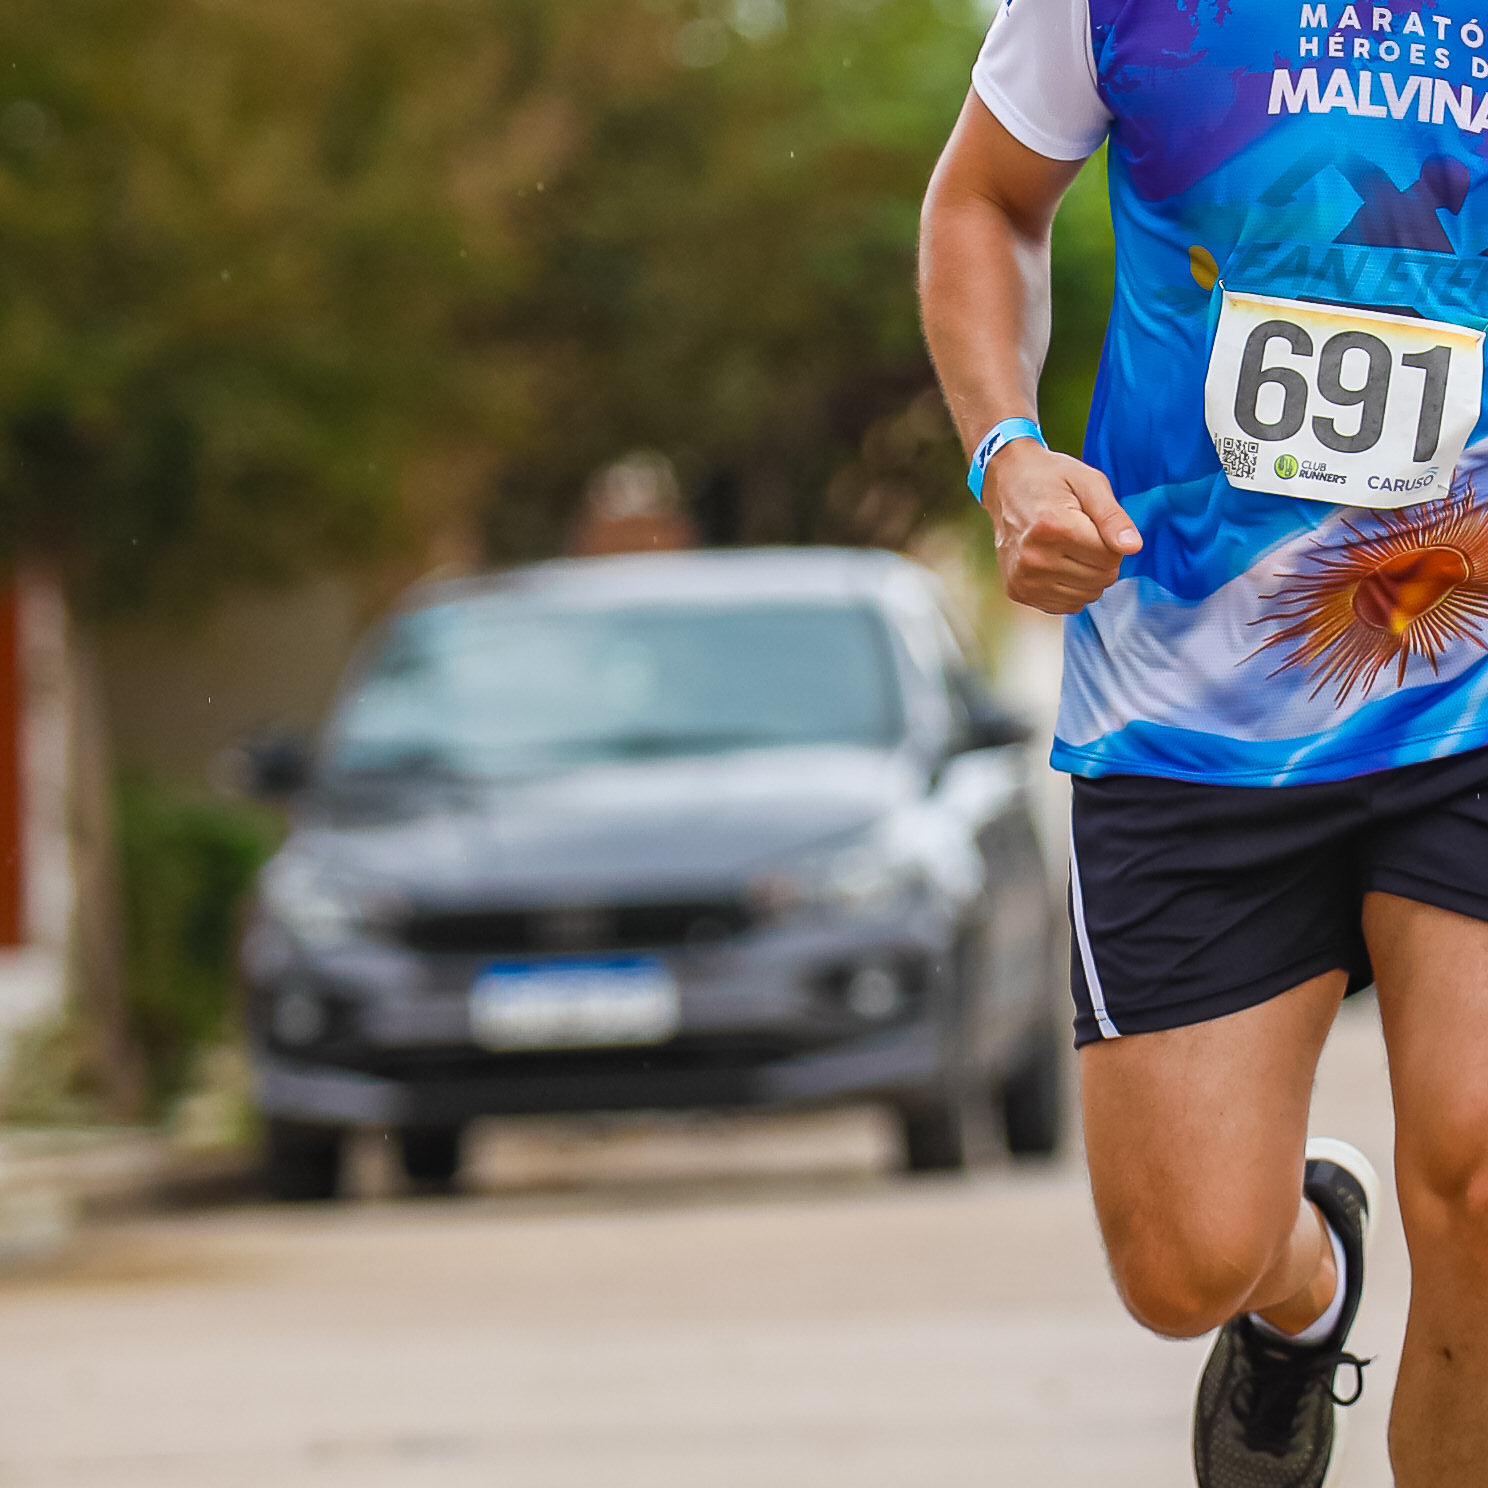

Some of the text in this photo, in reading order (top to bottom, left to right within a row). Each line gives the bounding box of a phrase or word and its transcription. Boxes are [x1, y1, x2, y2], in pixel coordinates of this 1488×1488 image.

[1299, 32, 1451, 70] HÉROES
[1233, 319, 1452, 463] 691
[1301, 459, 1328, 472] CLUB
[1367, 473, 1435, 493] CARUSO
